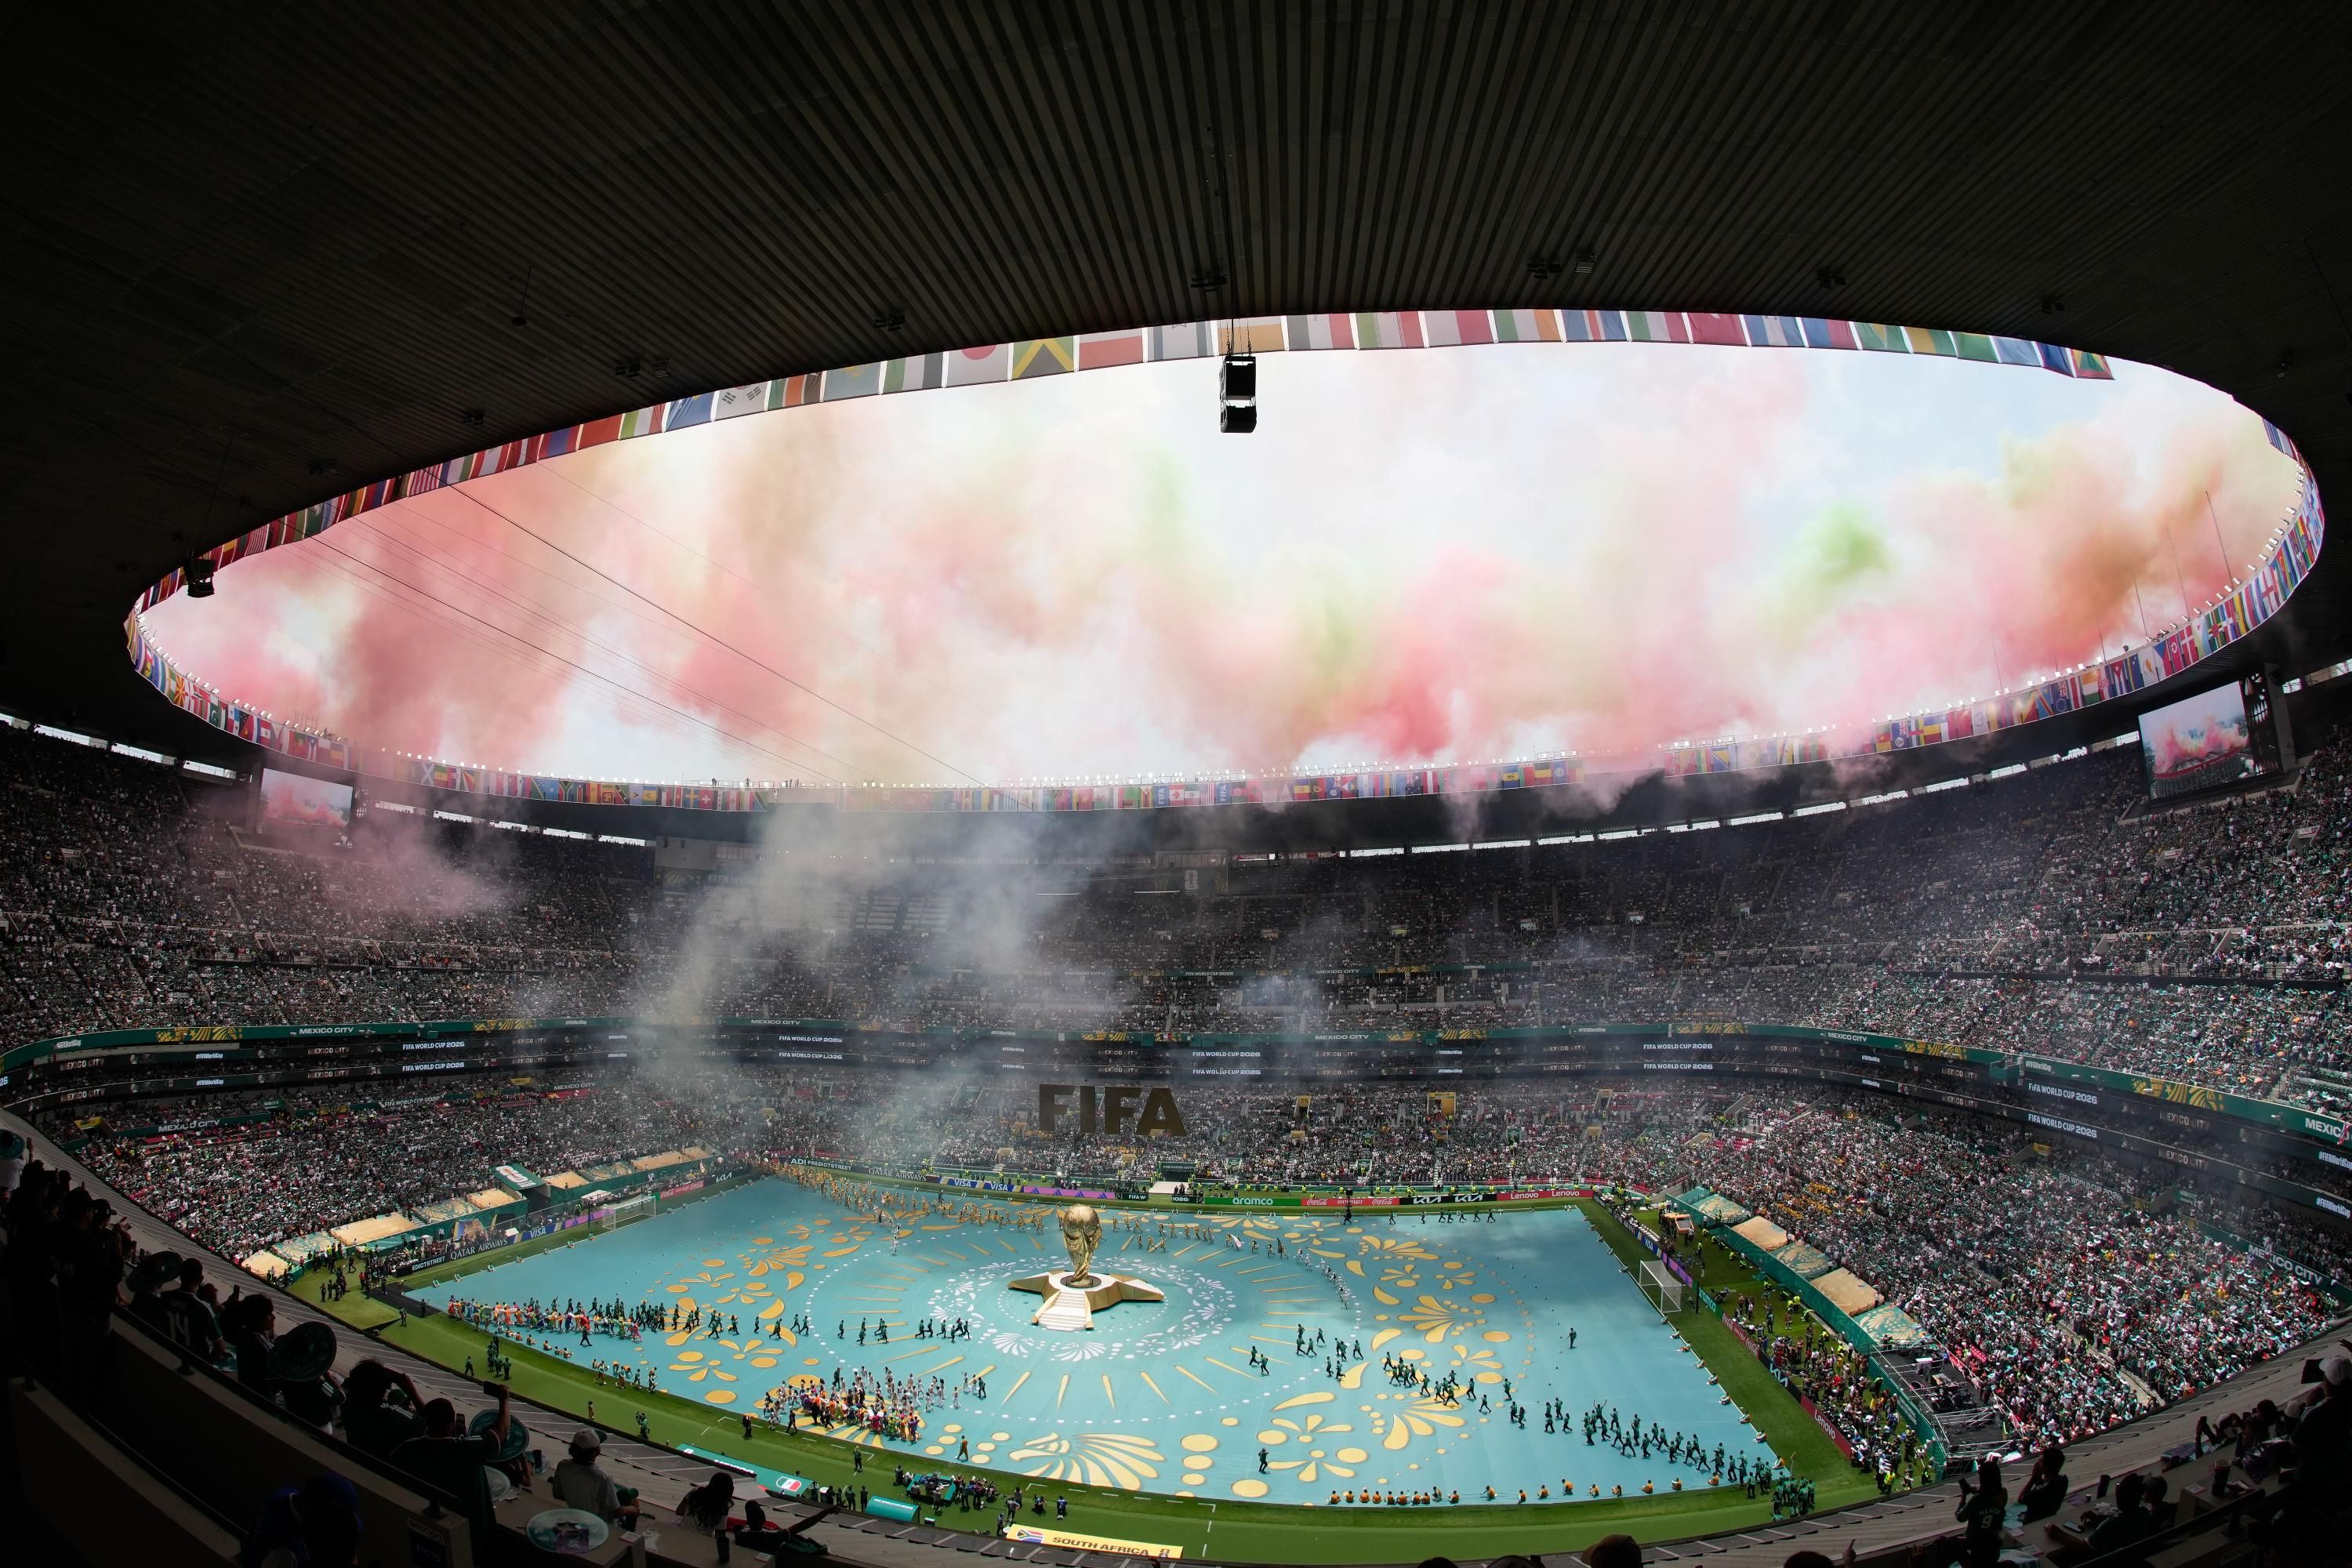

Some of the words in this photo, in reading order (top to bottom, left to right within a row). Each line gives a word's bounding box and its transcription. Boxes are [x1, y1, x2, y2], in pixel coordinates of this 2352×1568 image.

[708, 874, 728, 883] FIFA
[1828, 1032, 1850, 1040] MEXICO
[60, 1060, 86, 1071] MEXICO
[88, 1058, 106, 1067] CITY
[1942, 1067, 1963, 1077] MEXICO
[60, 1091, 86, 1102] MEXICO
[88, 1088, 106, 1098] CITY
[1942, 1096, 1963, 1105] MEXICO
[2028, 1083, 2042, 1093] FIFA
[2042, 1085, 2062, 1097] WORLD
[2063, 1089, 2075, 1099] CUP
[2076, 1092, 2098, 1105] 2026
[1039, 1083, 1188, 1137] FIFA
[198, 1119, 220, 1129] CITY
[2028, 1114, 2040, 1123] FIFA
[2041, 1116, 2062, 1129] WORLD
[2063, 1122, 2075, 1132] CUP
[2075, 1126, 2097, 1138] 2026
[2160, 1111, 2189, 1127] MEXICO
[2190, 1118, 2210, 1130] CITY
[1951, 1138, 1969, 1149] CITY
[807, 1160, 851, 1171] PREDICTSTREET
[2159, 1149, 2188, 1164] MEXICO
[2190, 1156, 2209, 1170] CITY
[716, 1173, 731, 1182] KIA
[869, 1168, 892, 1177] QATAR
[895, 1171, 927, 1181] AIRWAYS
[2060, 1172, 2071, 1182] FIFA
[1454, 1194, 1483, 1203] KIA
[530, 1226, 546, 1239] VISA
[451, 1246, 475, 1260] QATAR
[478, 1238, 508, 1252] AIRWAYS
[1645, 1236, 1653, 1251] VISA
[2294, 1264, 2324, 1285] CITY
[1769, 1362, 1788, 1387] KIA
[1814, 1409, 1835, 1439] Lenovo
[1053, 1537, 1098, 1548] SOUTH
[1099, 1544, 1149, 1556] AFRICA
